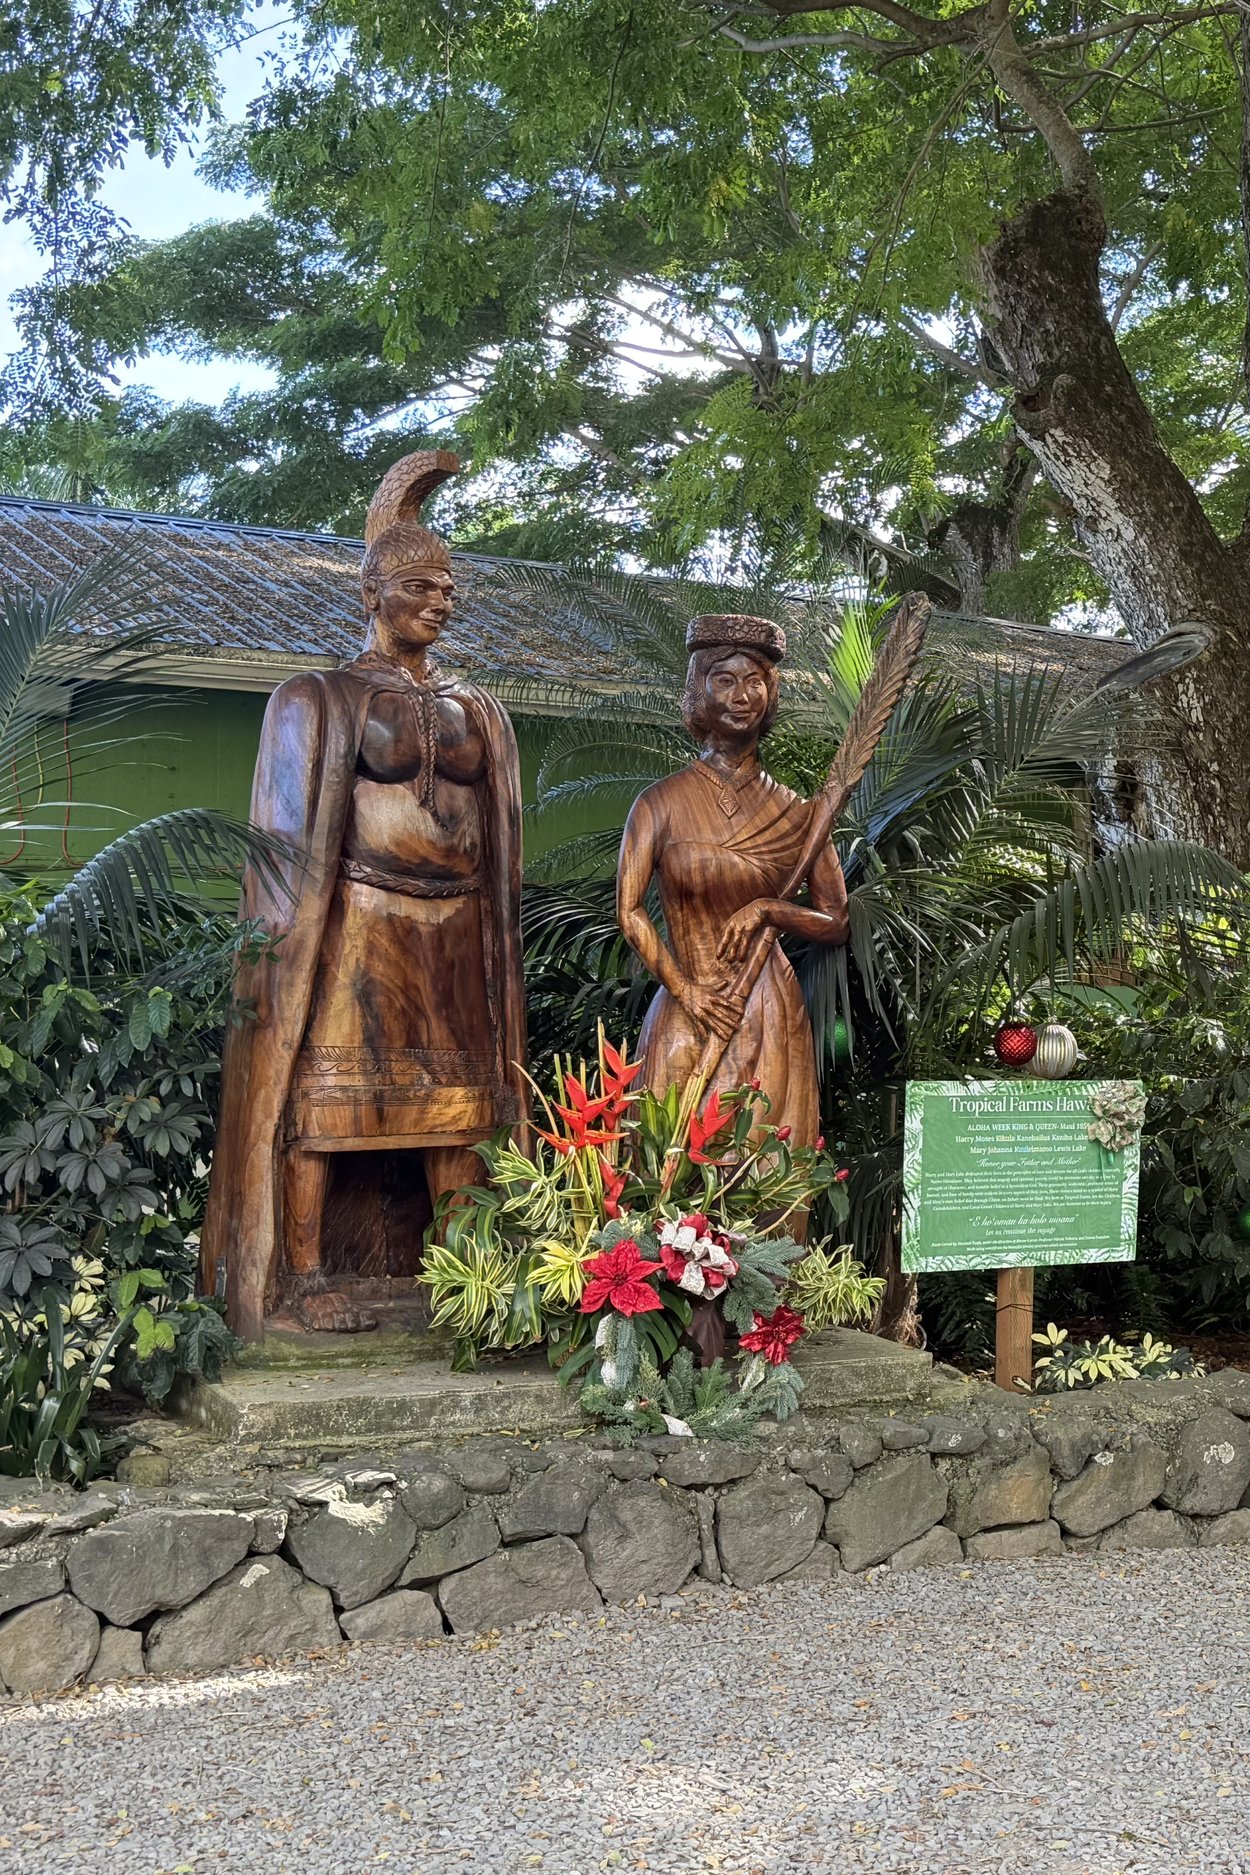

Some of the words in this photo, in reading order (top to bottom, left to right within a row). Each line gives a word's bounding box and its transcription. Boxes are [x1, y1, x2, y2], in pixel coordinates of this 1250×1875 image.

[948, 1096, 1007, 1117] Tropical
[1009, 1096, 1054, 1112] Farms
[1056, 1096, 1094, 1112] Hawa
[992, 1123, 1011, 1131] WEEK
[1012, 1123, 1028, 1131] KING
[955, 1135, 975, 1144] Harry
[1074, 1133, 1088, 1141] Lake
[970, 1146, 987, 1155] Mary
[1053, 1144, 1071, 1152] Lewis
[1072, 1144, 1087, 1152] Lake
[1029, 1213, 1047, 1225] holo
[985, 1228, 994, 1236] Let
[1037, 1227, 1056, 1236] voyage
